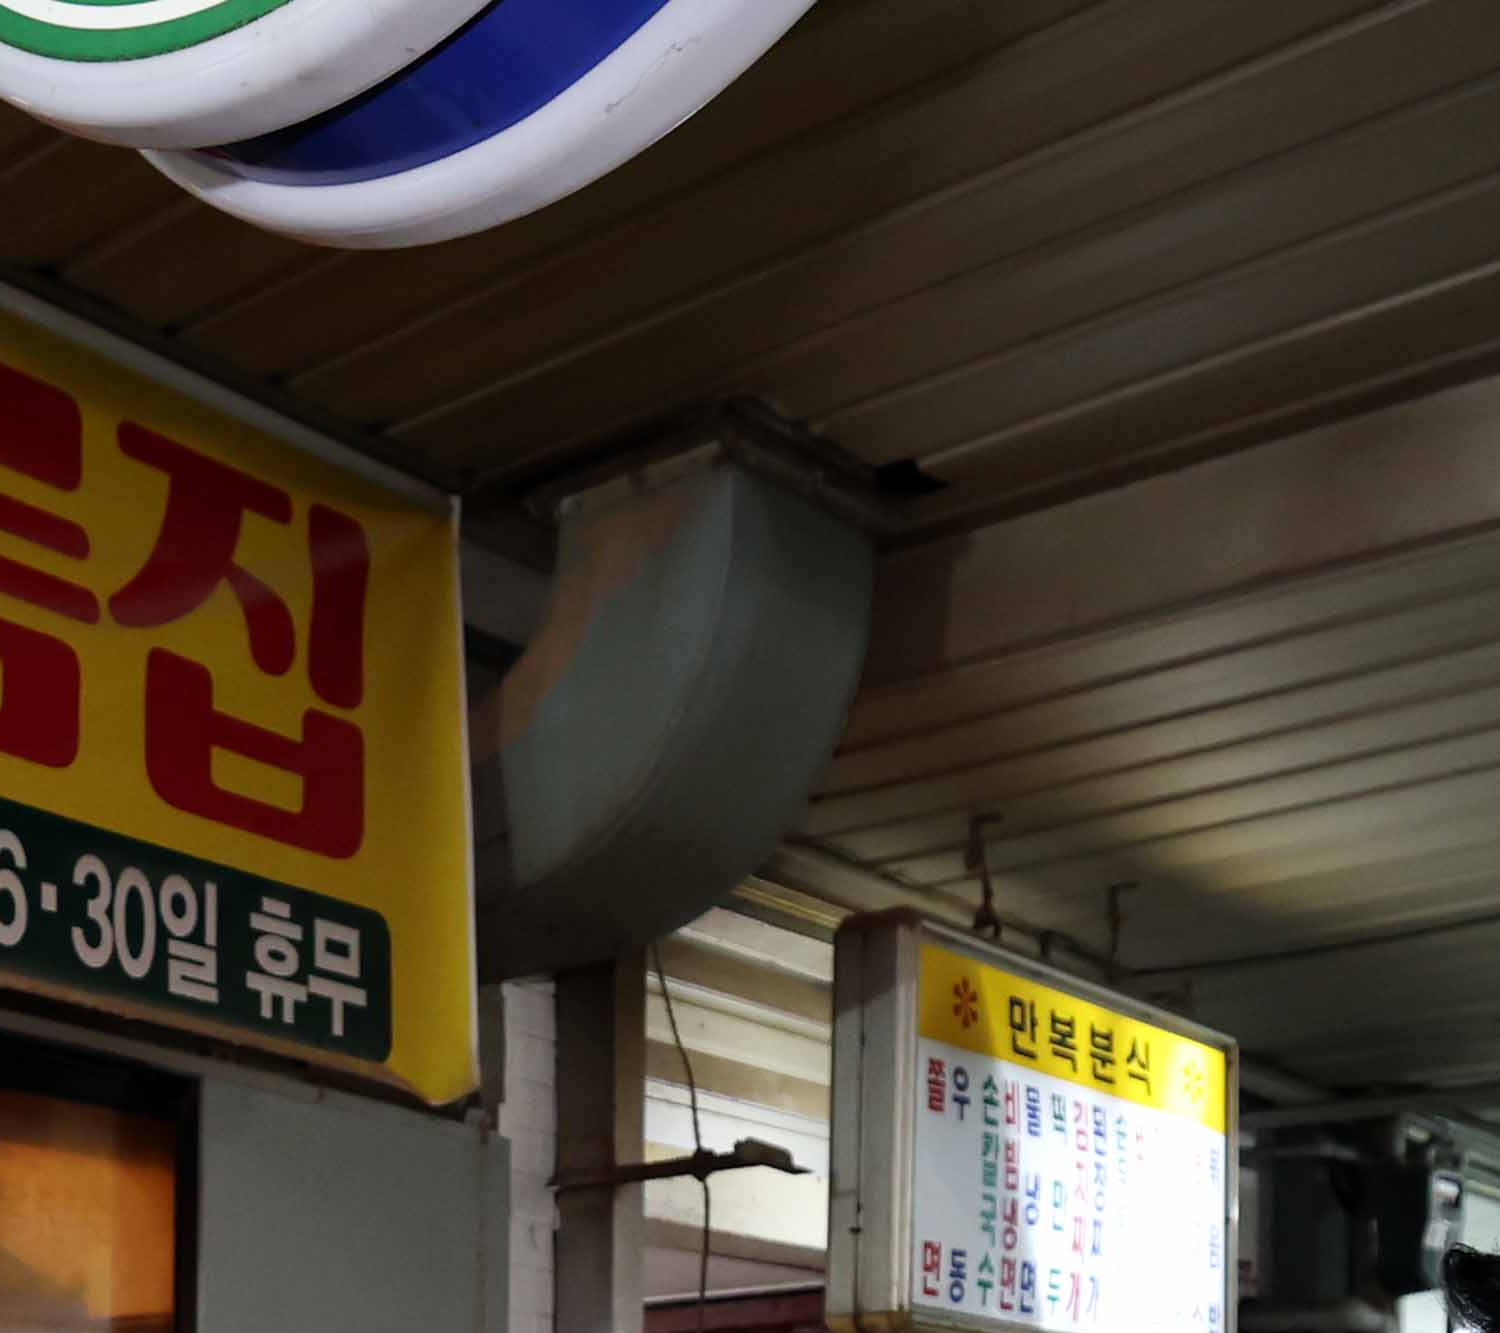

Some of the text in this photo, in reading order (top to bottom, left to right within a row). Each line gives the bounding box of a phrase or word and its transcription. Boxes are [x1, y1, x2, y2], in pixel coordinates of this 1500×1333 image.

[246, 899, 367, 1037] 휴무
[1008, 996, 1152, 1096] 만복분식
[949, 1066, 970, 1303] 우동
